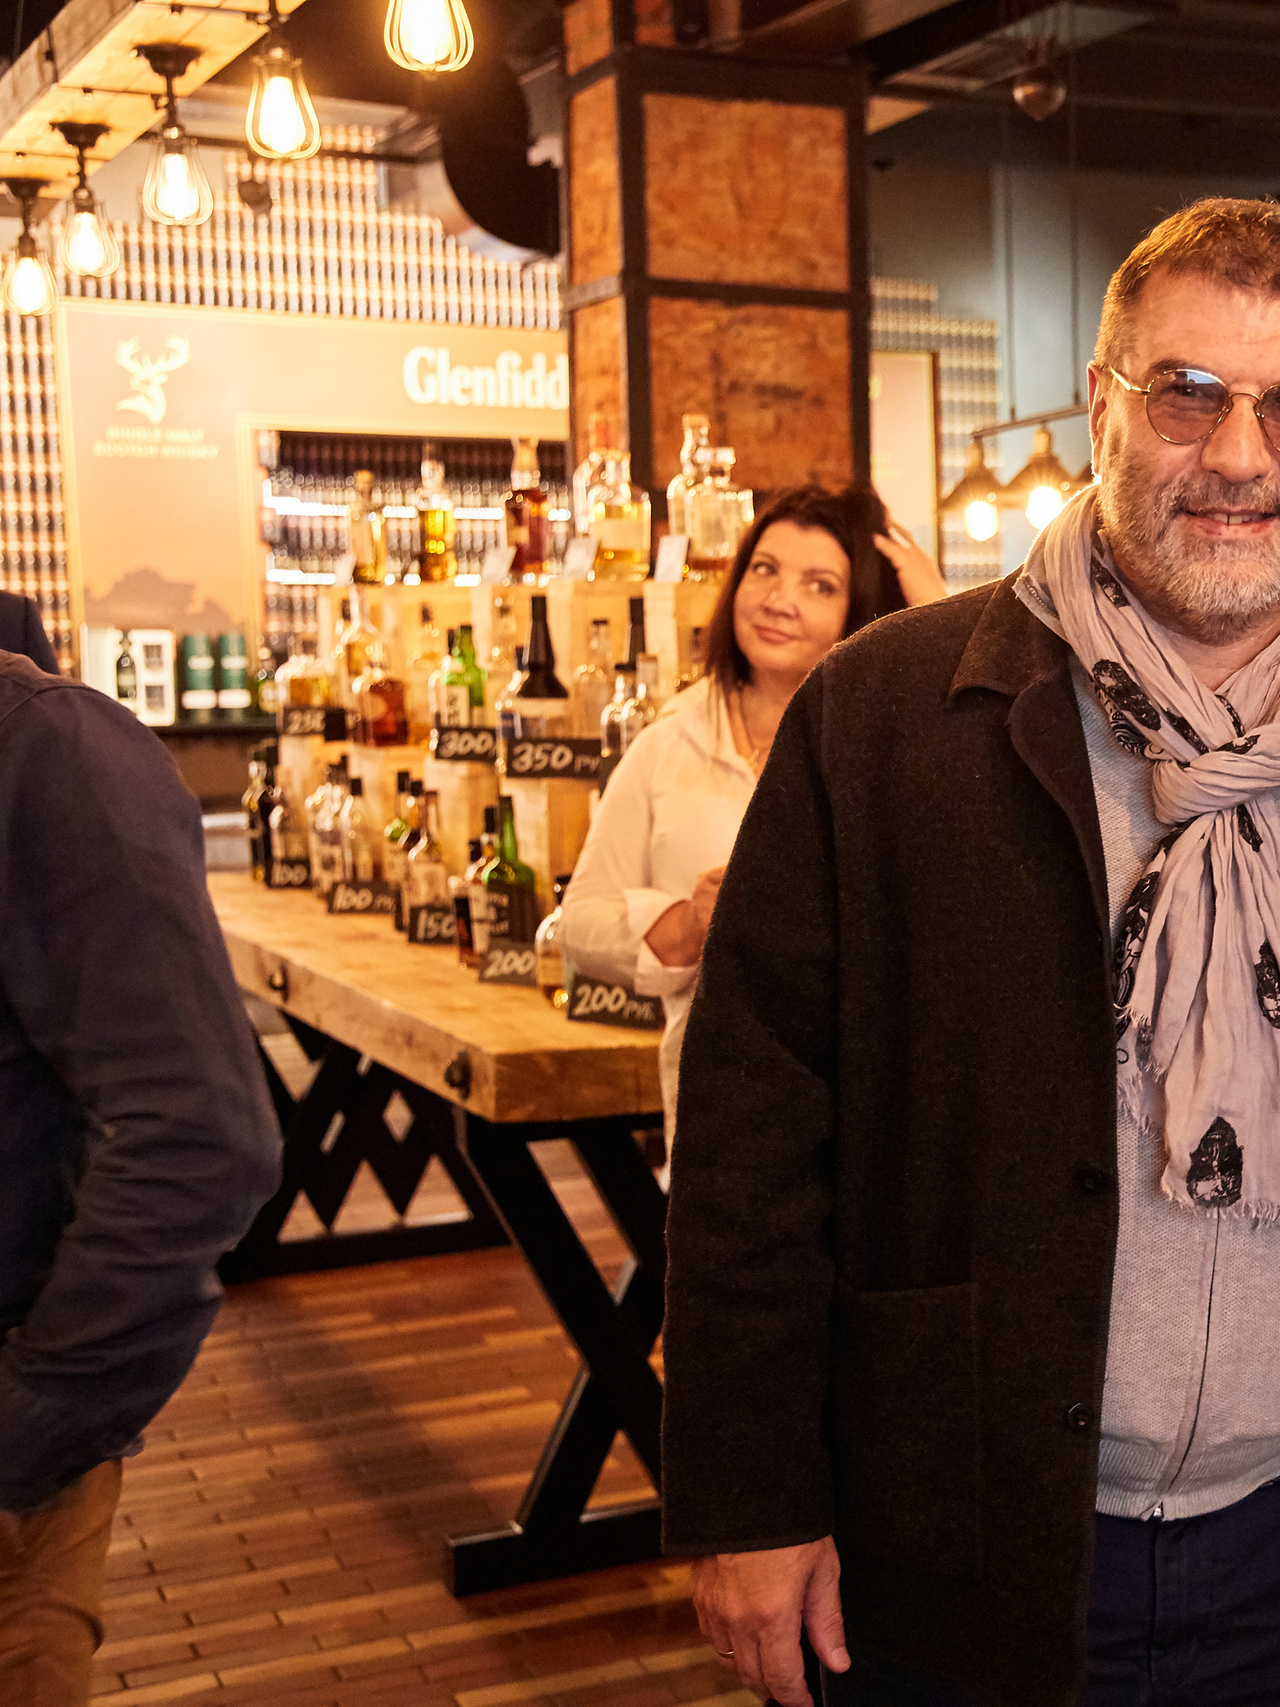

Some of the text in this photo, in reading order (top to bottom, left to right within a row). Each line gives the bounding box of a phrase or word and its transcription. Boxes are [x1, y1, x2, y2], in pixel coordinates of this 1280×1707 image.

[511, 742, 573, 773] 350
[333, 884, 374, 911] 100
[483, 949, 536, 978] 200
[572, 984, 627, 1016] 200
